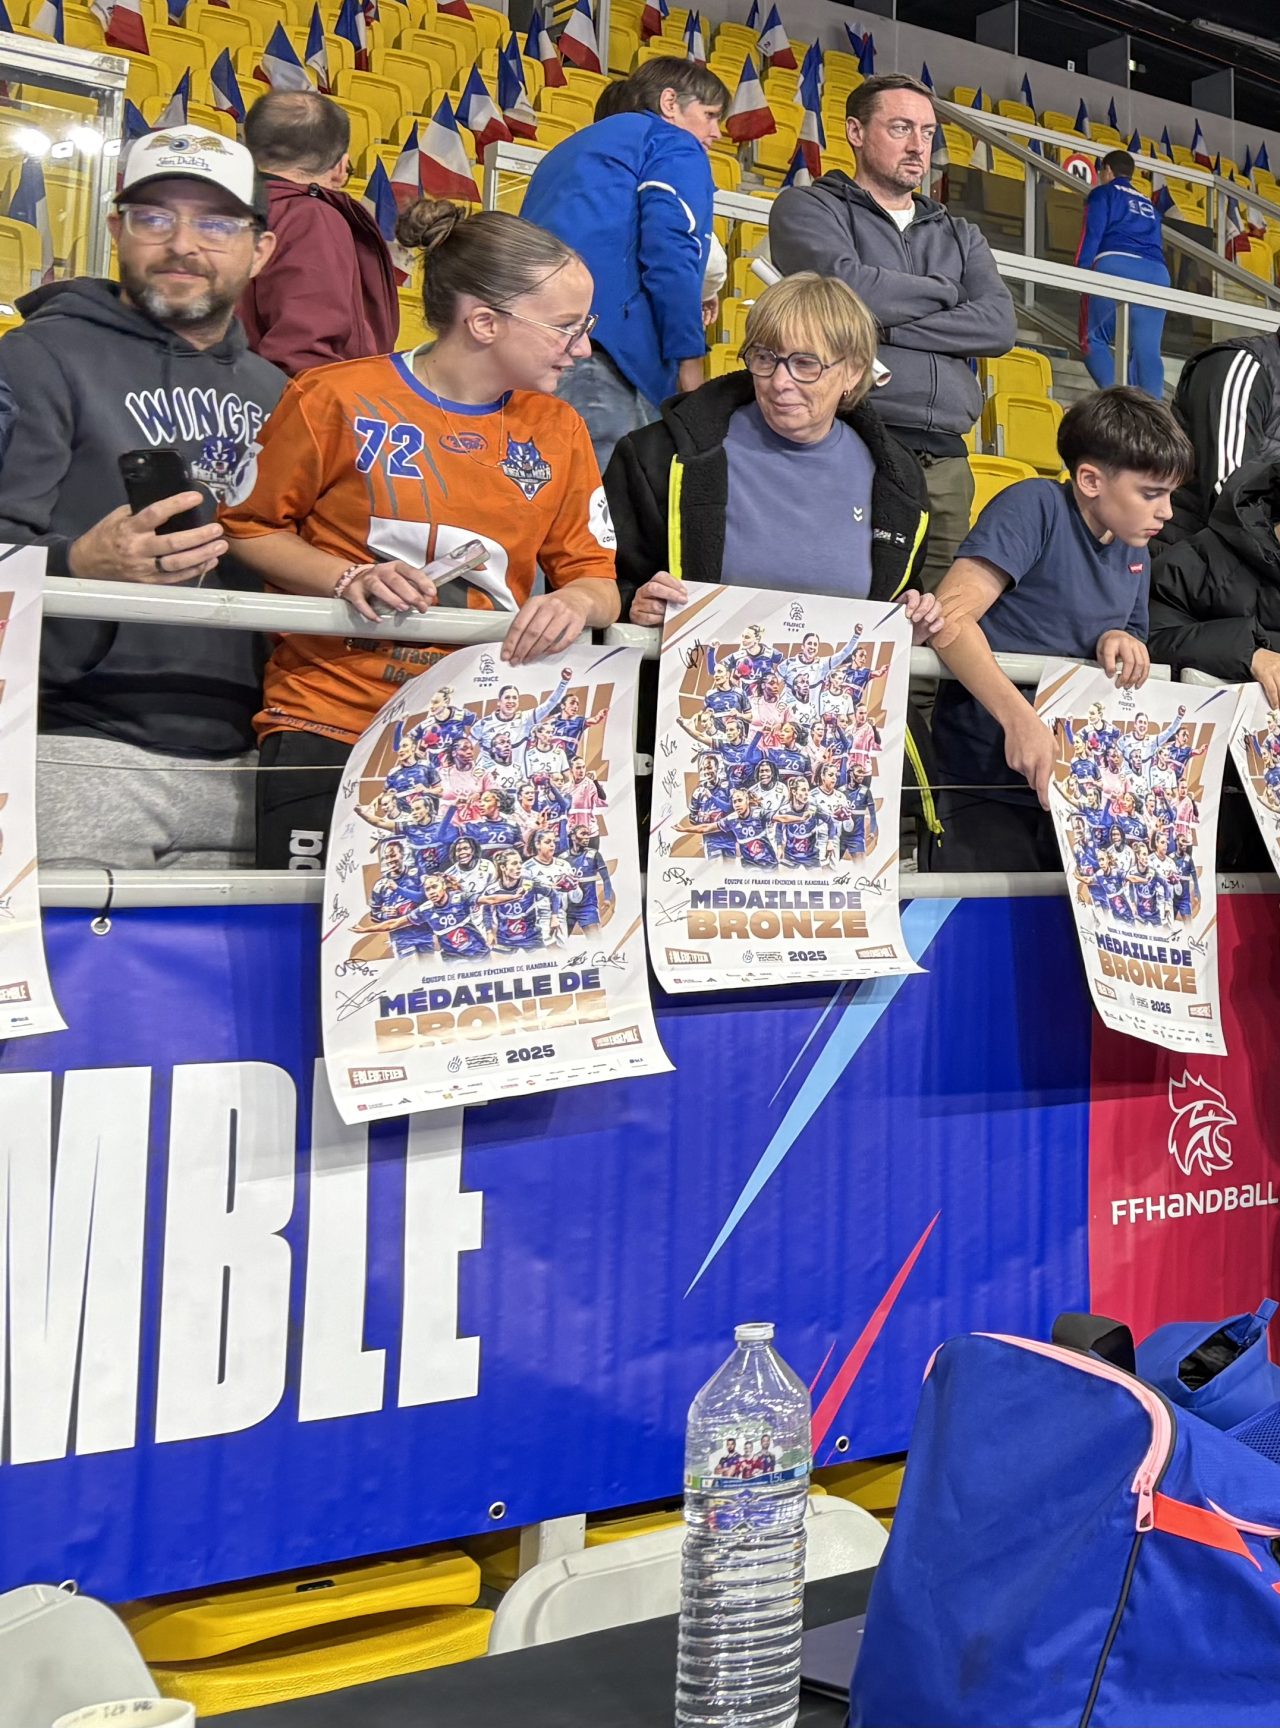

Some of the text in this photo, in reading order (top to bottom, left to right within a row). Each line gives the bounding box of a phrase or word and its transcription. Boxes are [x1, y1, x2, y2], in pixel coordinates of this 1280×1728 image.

[125, 387, 272, 447] WINGE
[354, 416, 424, 479] 72
[783, 621, 806, 629] FRANCE
[785, 759, 800, 770] 26
[501, 776, 514, 788] 29
[488, 831, 507, 844] 26
[742, 826, 756, 838] 98
[792, 823, 806, 835] 28
[690, 887, 862, 910] MÉDAILLE DE
[504, 902, 522, 915] 28
[439, 912, 457, 928] 98
[687, 910, 869, 940] BRONZE
[788, 950, 828, 962] 2025
[1095, 932, 1167, 964] MÉDAILLE
[1170, 949, 1192, 966] DE
[457, 969, 483, 980] FRANCE
[525, 960, 559, 971] HANDBALL
[1097, 949, 1197, 994] BRONZE
[379, 976, 556, 1018] MÉDAILLE
[559, 967, 601, 990] DE
[1150, 1000, 1172, 1014] 2025
[374, 989, 610, 1054] BRONZE
[505, 1044, 556, 1064] 2025
